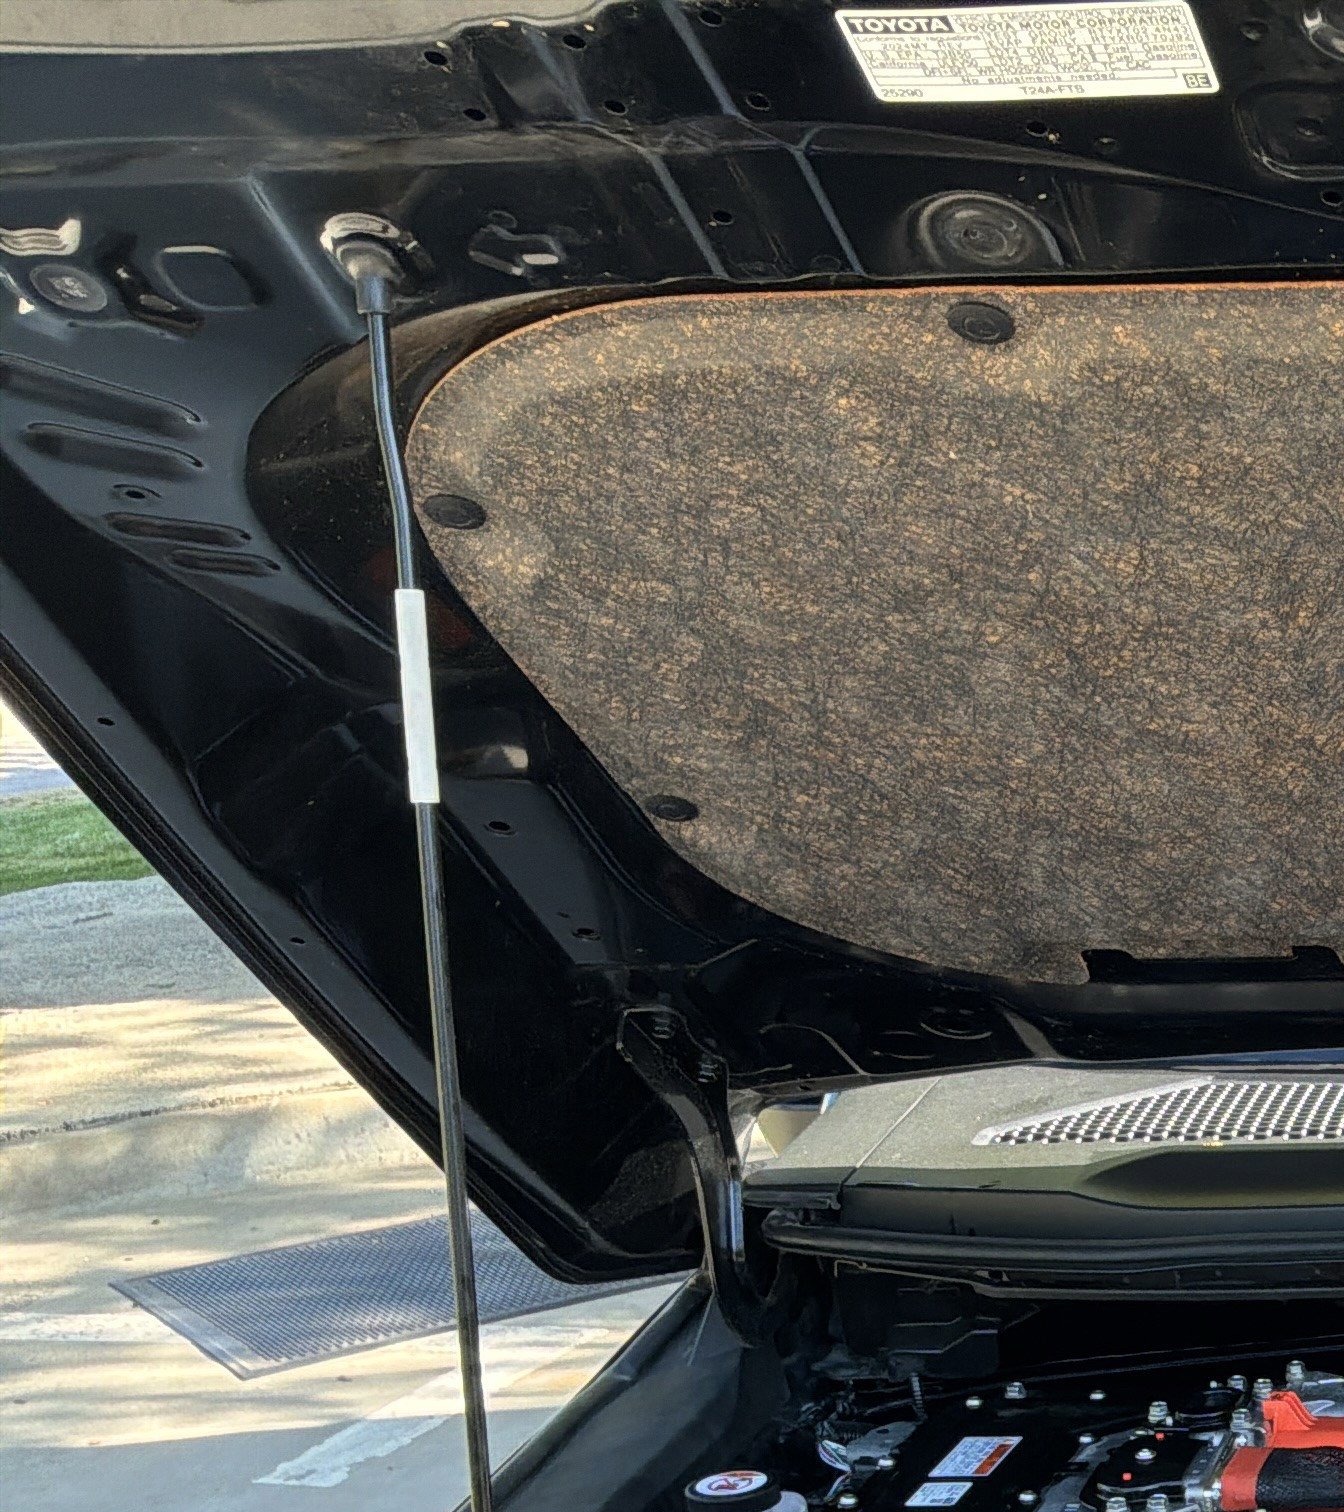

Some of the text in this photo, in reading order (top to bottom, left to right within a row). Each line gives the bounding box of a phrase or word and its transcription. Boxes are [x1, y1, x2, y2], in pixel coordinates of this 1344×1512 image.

[849, 17, 949, 32] TOYOTA
[959, 15, 1182, 32] TOYOTA MOTOR CORPORATION
